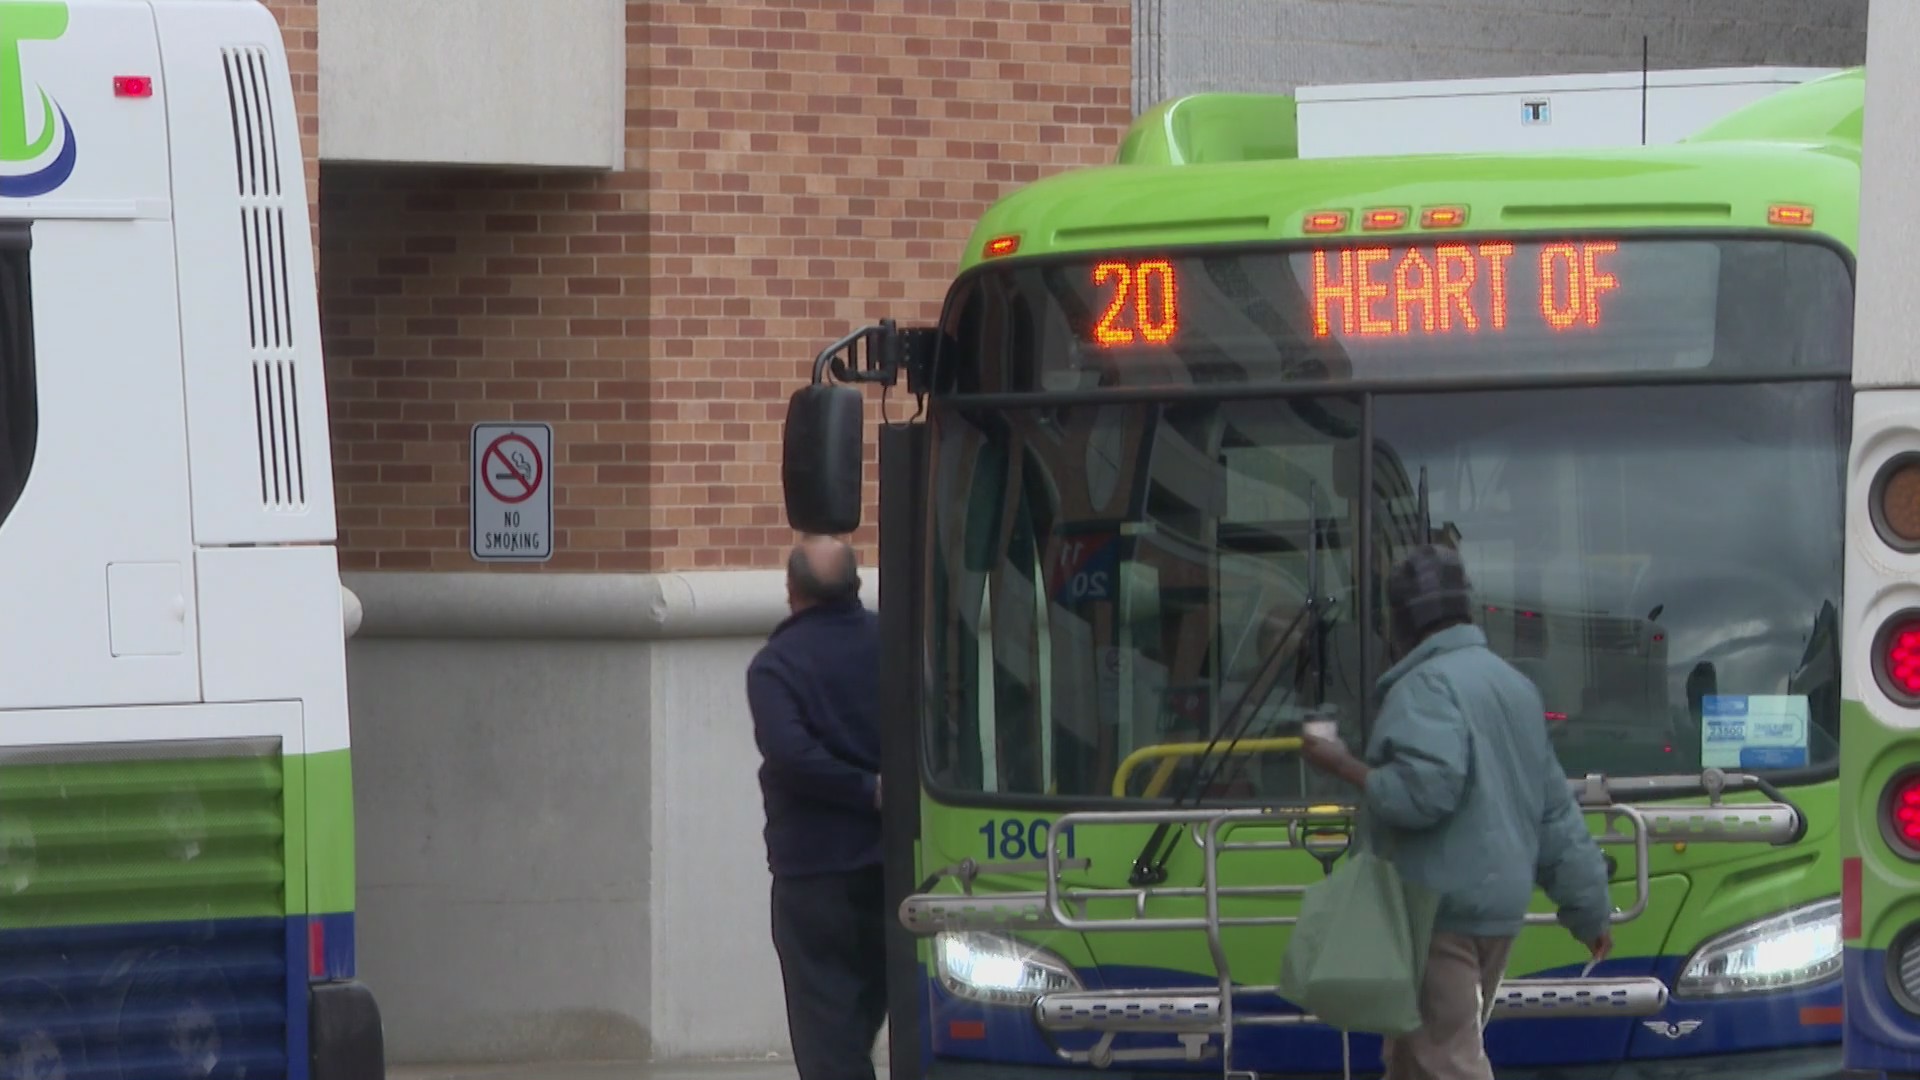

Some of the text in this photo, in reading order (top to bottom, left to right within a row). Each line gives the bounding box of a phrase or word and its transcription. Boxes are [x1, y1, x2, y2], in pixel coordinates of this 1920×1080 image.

[1094, 240, 1620, 345] 20 HEART OF
[504, 511, 520, 528] NO
[485, 532, 540, 552] SMOKING
[979, 818, 1075, 860] 1801
